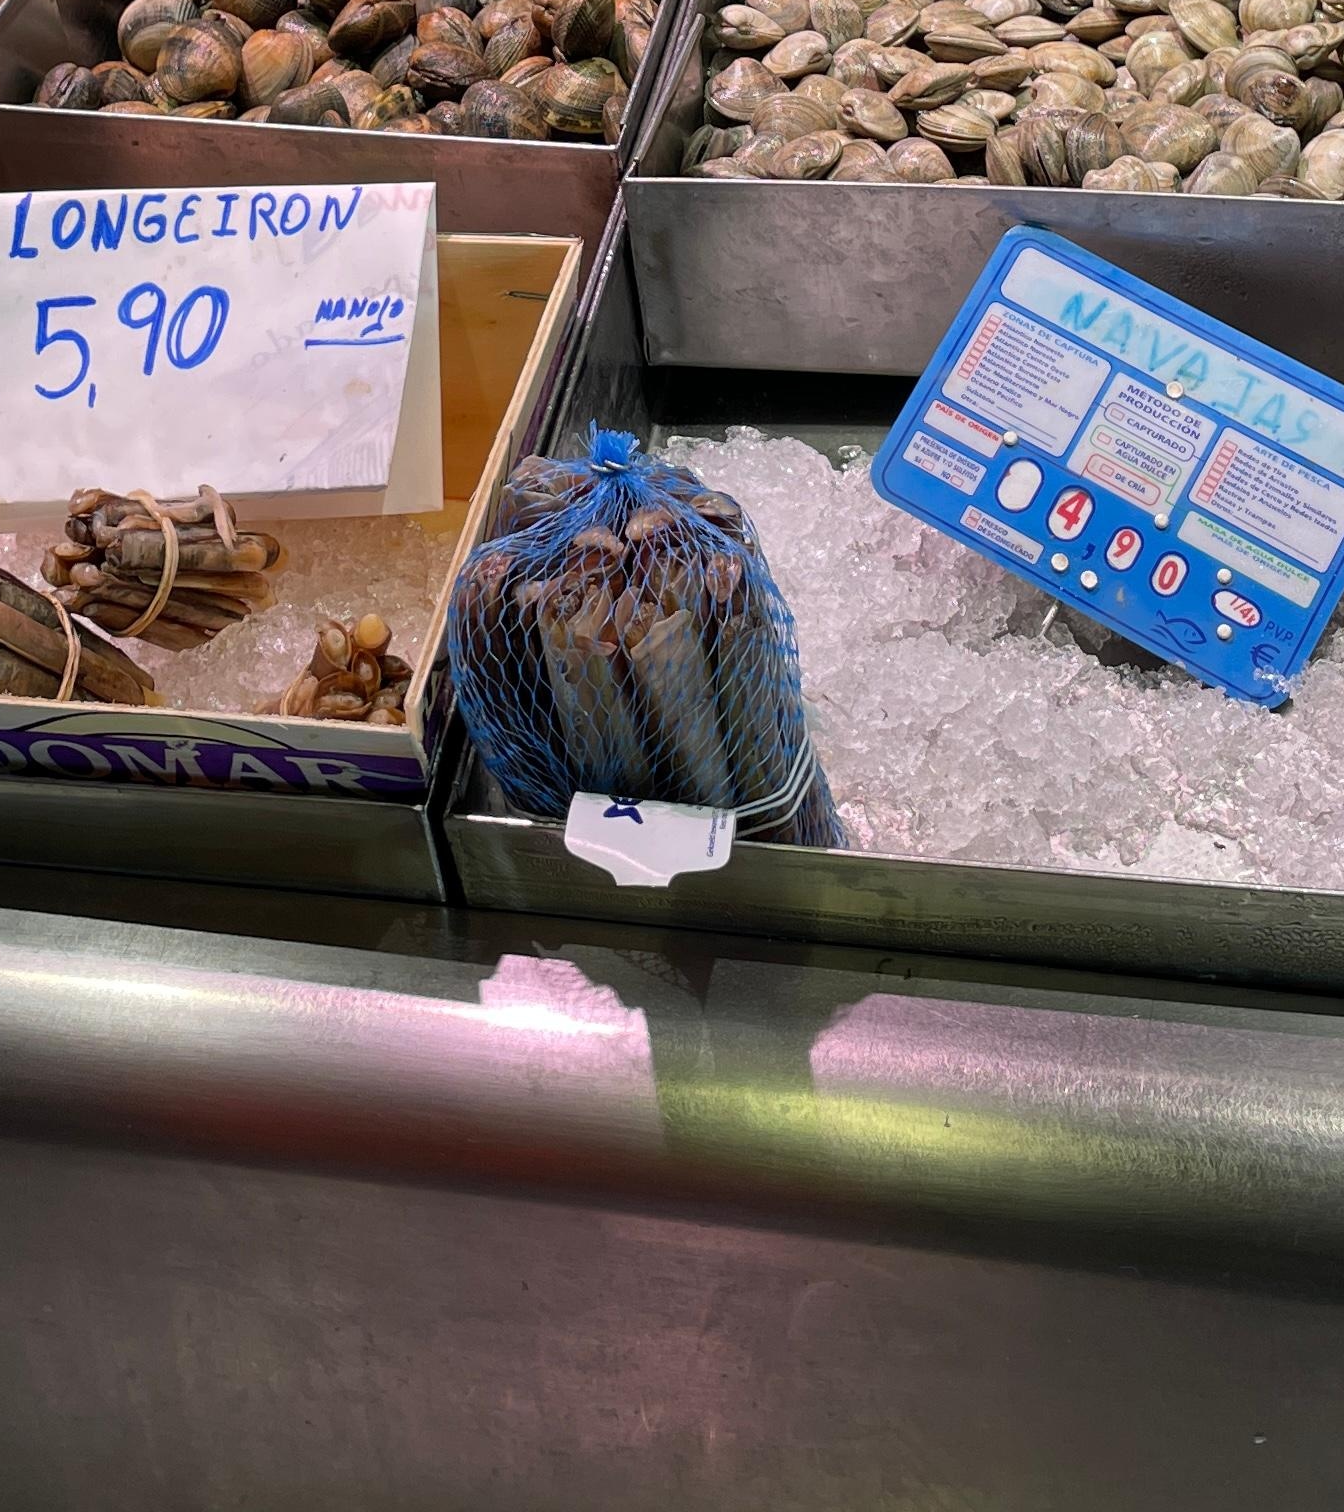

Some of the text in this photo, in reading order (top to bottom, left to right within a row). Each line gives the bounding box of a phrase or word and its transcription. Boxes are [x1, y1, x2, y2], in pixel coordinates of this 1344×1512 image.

[9, 186, 362, 258] LONGEIRON
[33, 281, 231, 408] 5,90
[1002, 310, 1100, 366] ZONAS DE CAPTURA
[1059, 290, 1326, 445] NAVAJAS
[953, 413, 966, 424] DE
[966, 420, 1000, 442] ORIGEN
[1125, 416, 1187, 454] CAPTURADO
[1183, 414, 1202, 429] DE
[1114, 437, 1176, 475] CAPTURADO EN
[1115, 447, 1167, 480] AGUA DULCE
[1252, 445, 1331, 491] ARTE DE PESCA
[1114, 472, 1127, 483] DE
[976, 523, 1035, 560] DESCONGELADO
[980, 517, 1008, 536] FRESCO
[1197, 517, 1310, 583] MASA DE AGUA DULCE
[1235, 545, 1249, 556] DE
[1251, 554, 1291, 579] ORIGEN
